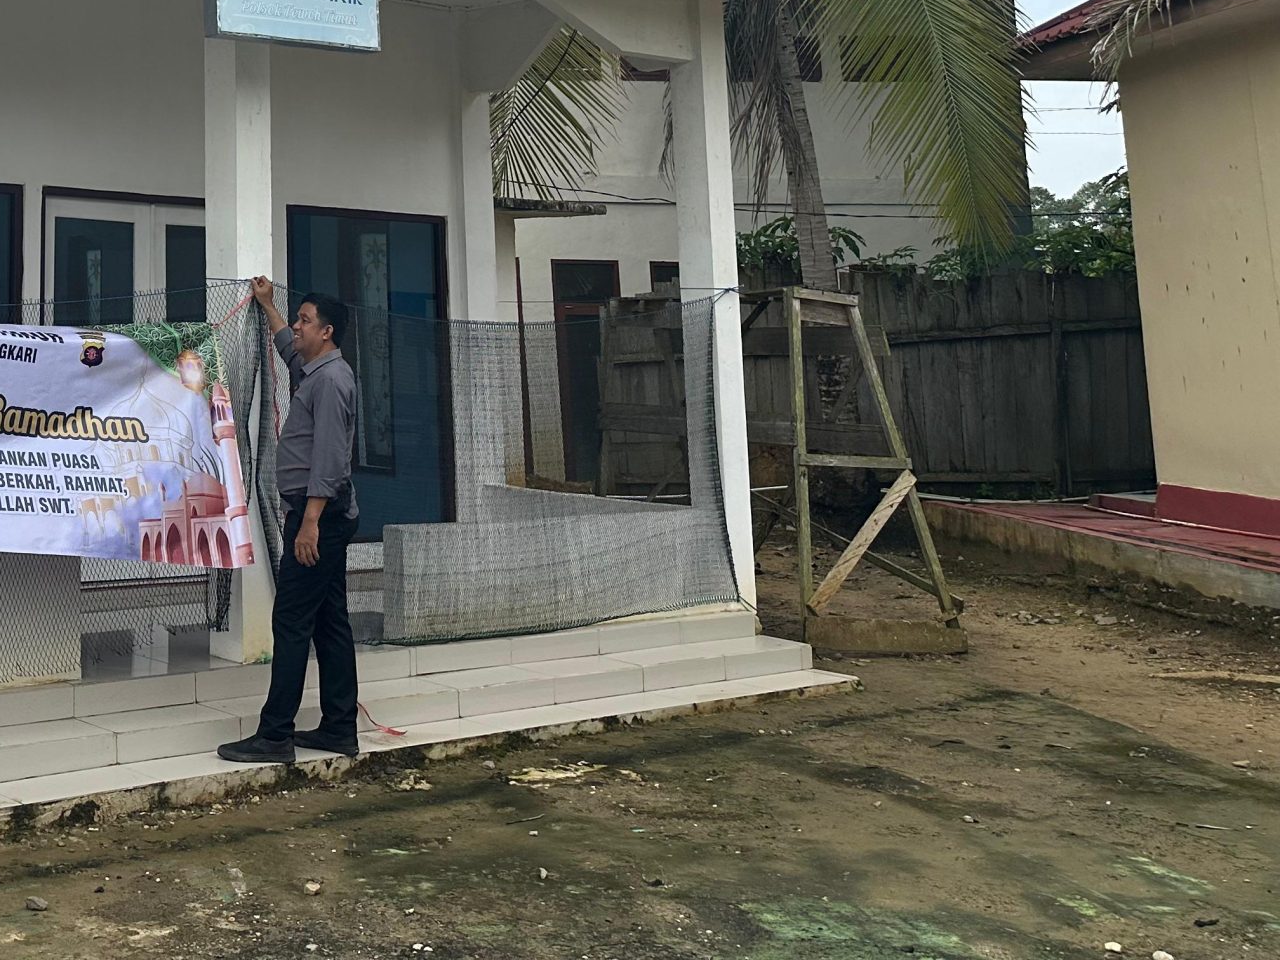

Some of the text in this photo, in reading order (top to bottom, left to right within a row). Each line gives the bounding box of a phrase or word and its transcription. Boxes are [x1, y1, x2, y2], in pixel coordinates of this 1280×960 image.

[241, 0, 282, 18] Polsek
[52, 452, 100, 470] PUASA
[64, 475, 128, 496] RAHMAT,
[39, 497, 75, 515] SWT.
